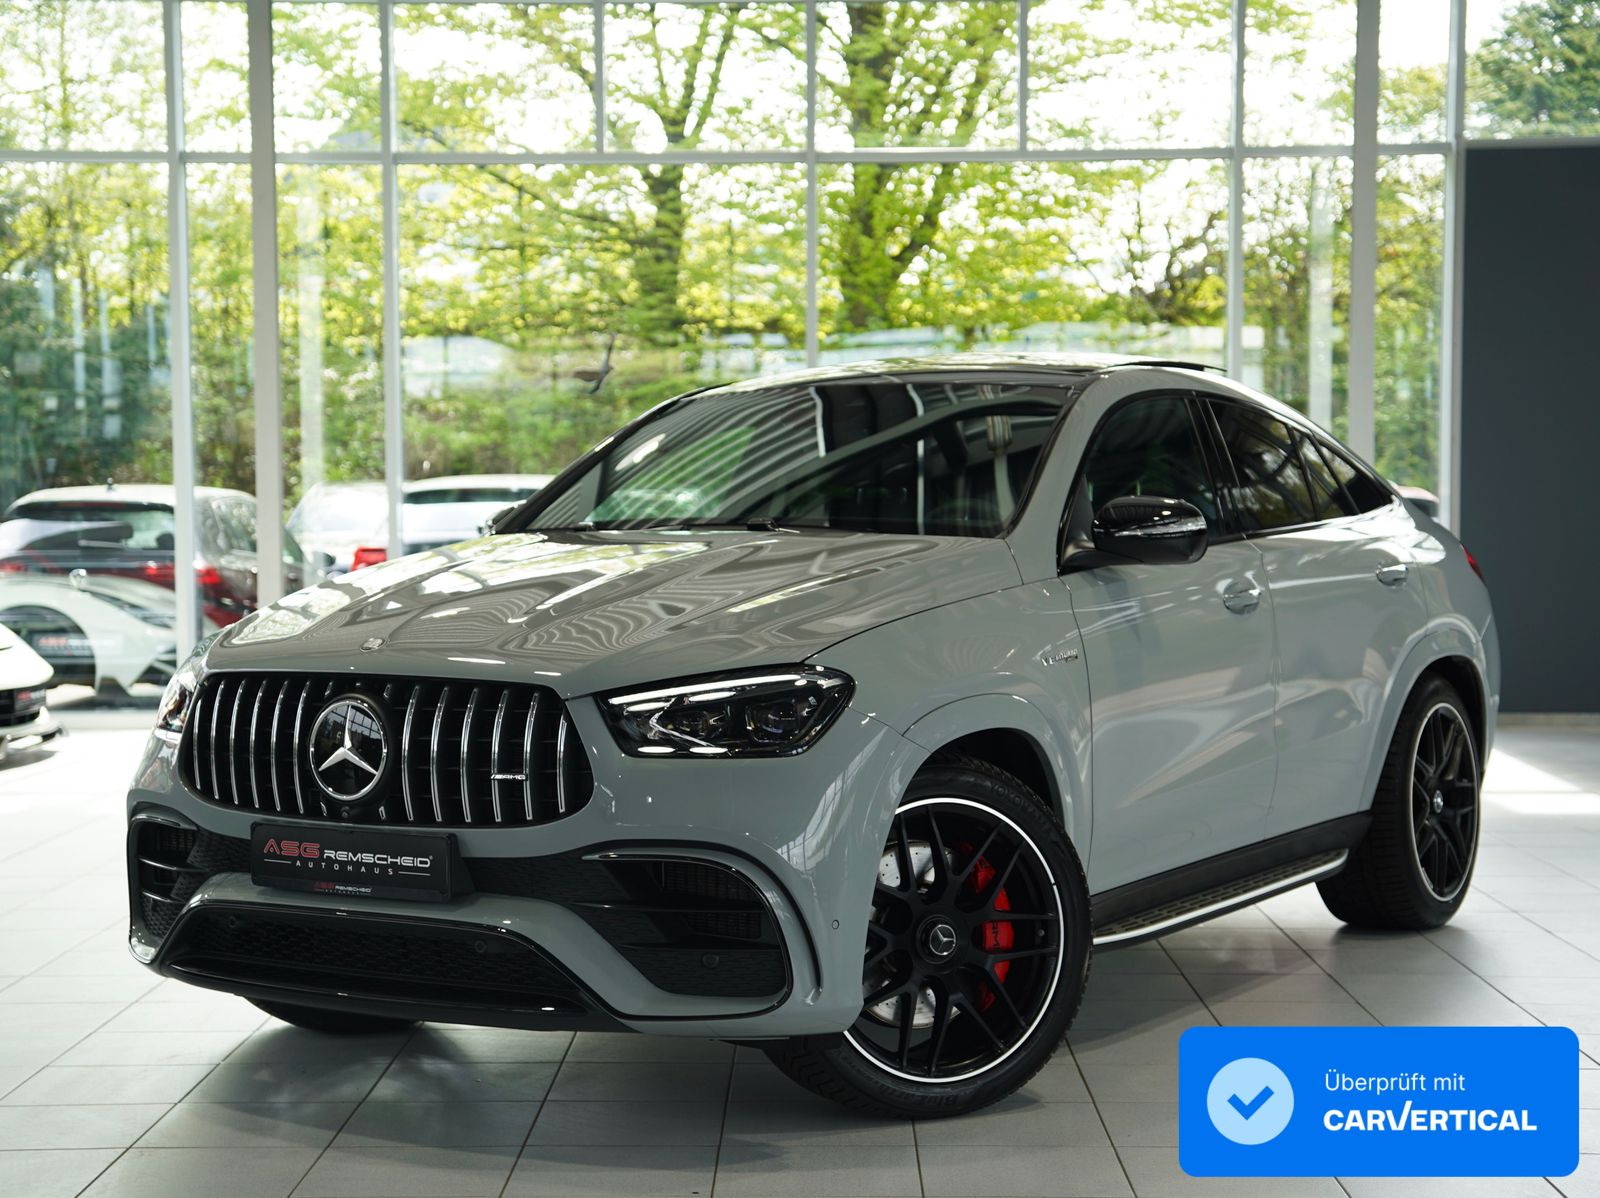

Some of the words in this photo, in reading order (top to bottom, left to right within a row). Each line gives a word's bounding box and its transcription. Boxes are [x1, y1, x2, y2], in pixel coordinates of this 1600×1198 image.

[263, 838, 320, 858] ASG
[323, 849, 431, 869] REMSCHEID
[295, 859, 394, 876] AUTOHAUS
